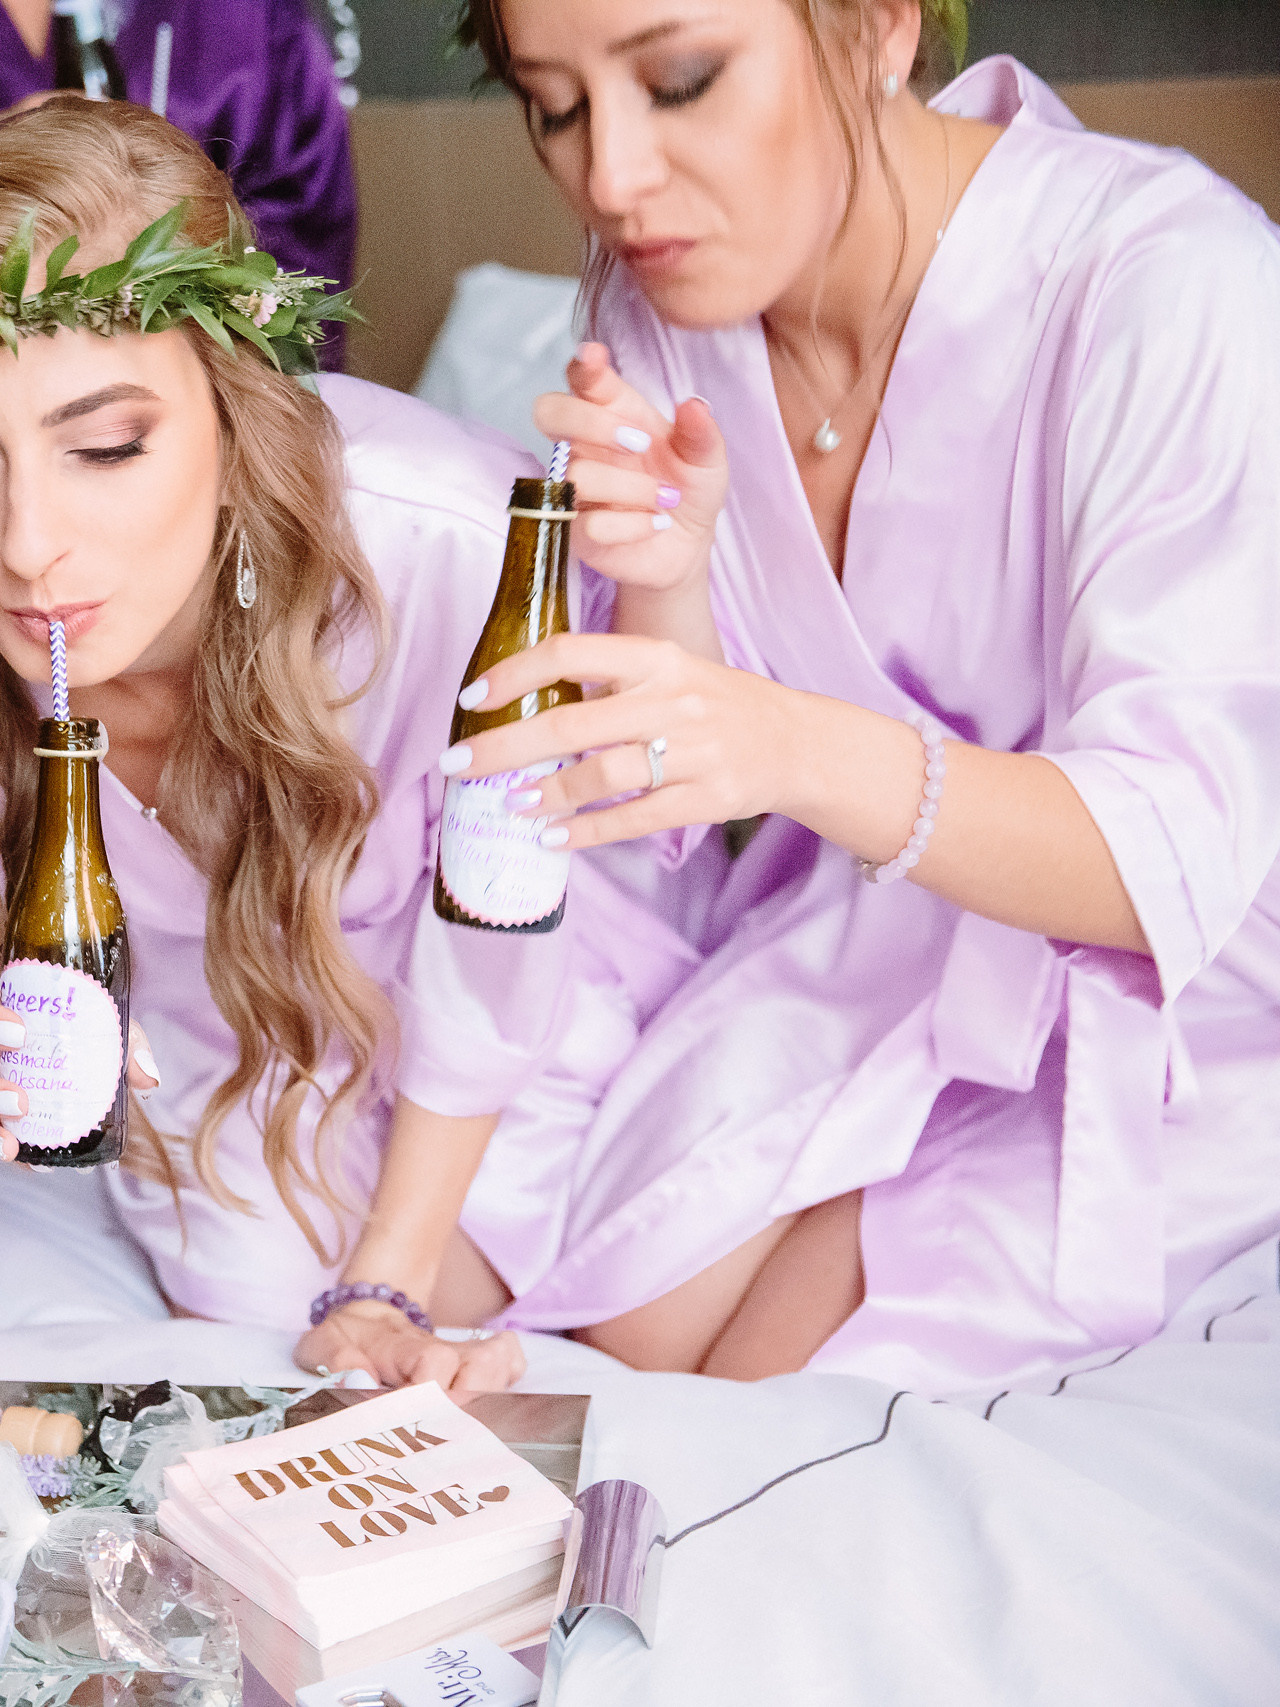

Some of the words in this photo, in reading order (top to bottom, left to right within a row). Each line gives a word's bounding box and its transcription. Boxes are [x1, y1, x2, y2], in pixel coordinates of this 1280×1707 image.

[0, 981, 76, 1021] Cheers!
[231, 1420, 450, 1501] DRUNK
[327, 1467, 419, 1510] ON
[316, 1483, 485, 1549] LOVE
[424, 1647, 482, 1680] Mrs.
[437, 1675, 484, 1707] Mr.
[473, 1681, 495, 1695] and
